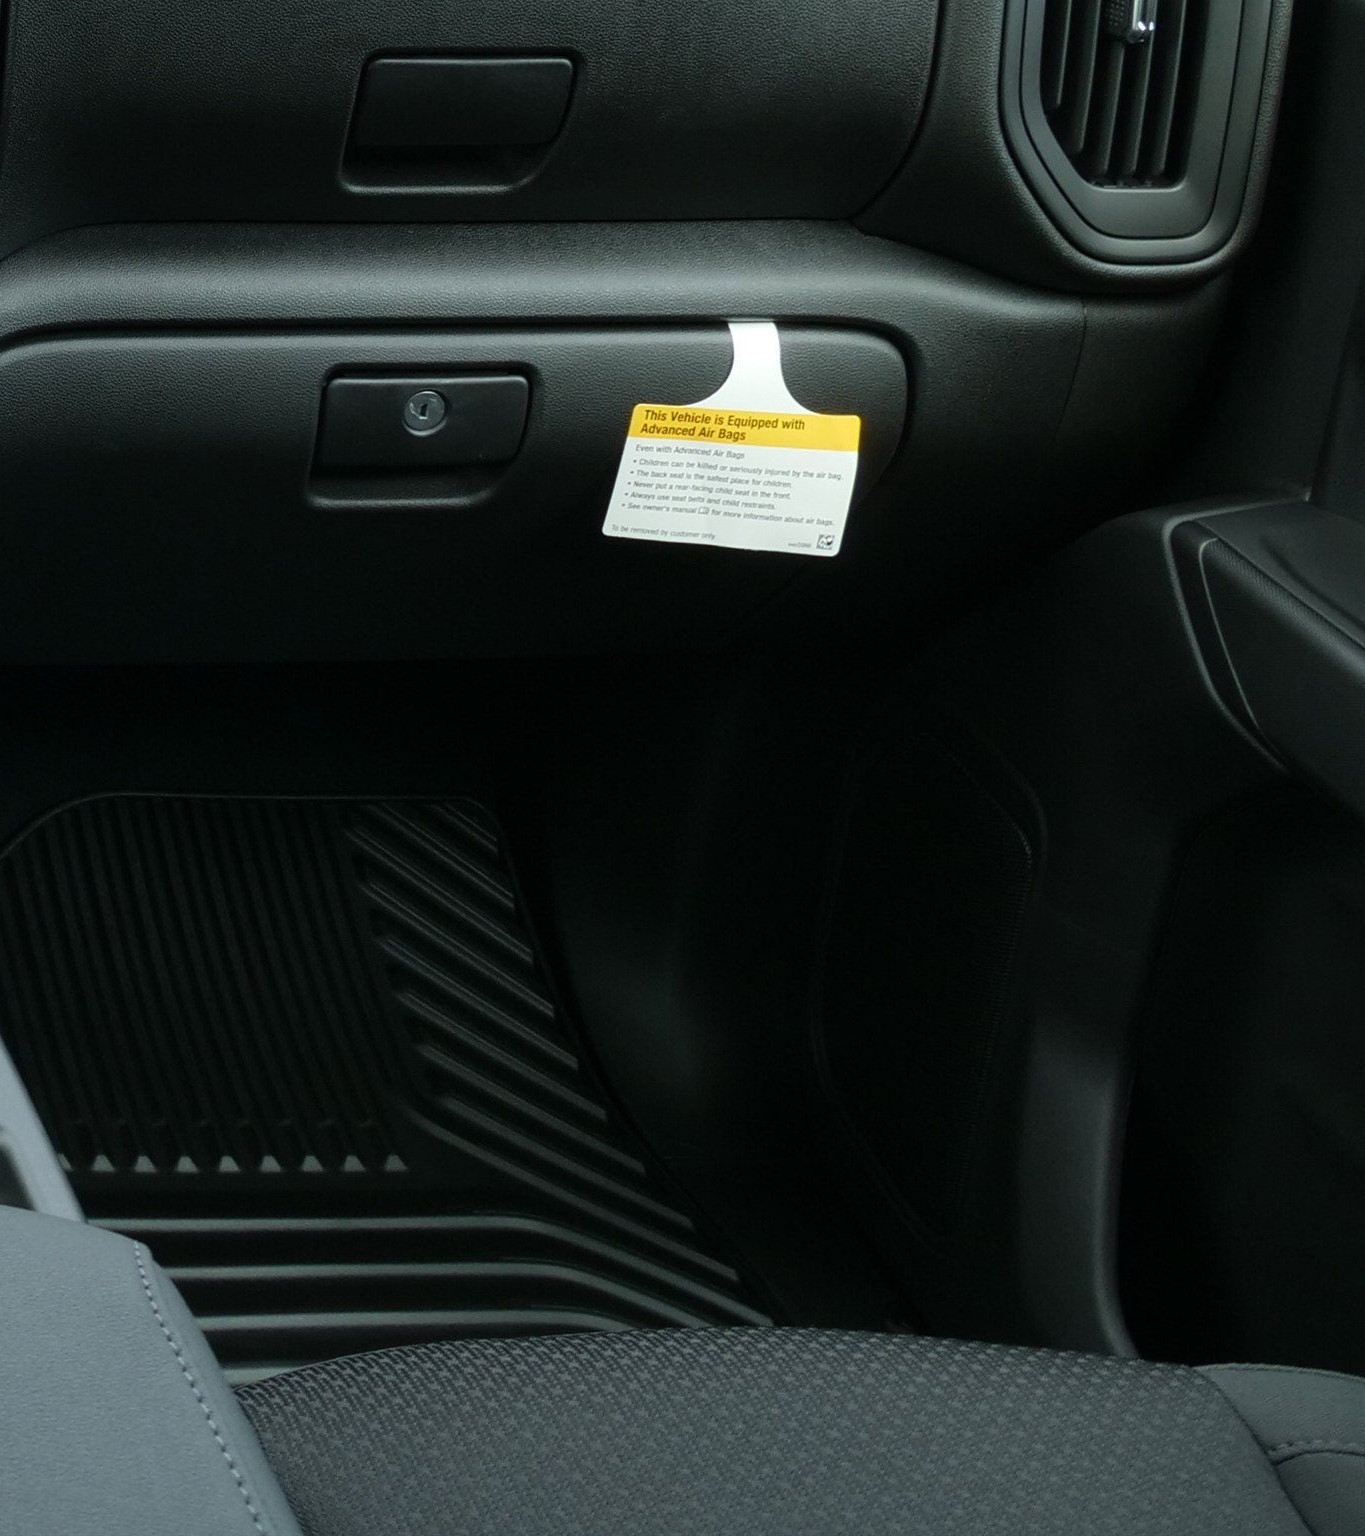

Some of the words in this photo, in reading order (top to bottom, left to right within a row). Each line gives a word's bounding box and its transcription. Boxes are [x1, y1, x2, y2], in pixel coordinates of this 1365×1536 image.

[645, 410, 667, 421] This
[671, 411, 711, 424] Vehicle
[714, 415, 724, 425] is
[728, 415, 778, 430] Equipped
[782, 419, 805, 430] with
[640, 423, 696, 437] Advanced
[698, 427, 716, 438] Air
[718, 428, 746, 443] Bags
[636, 444, 653, 452] Even
[656, 445, 671, 453] with
[673, 447, 711, 456] Advanced
[726, 451, 745, 460] Bags
